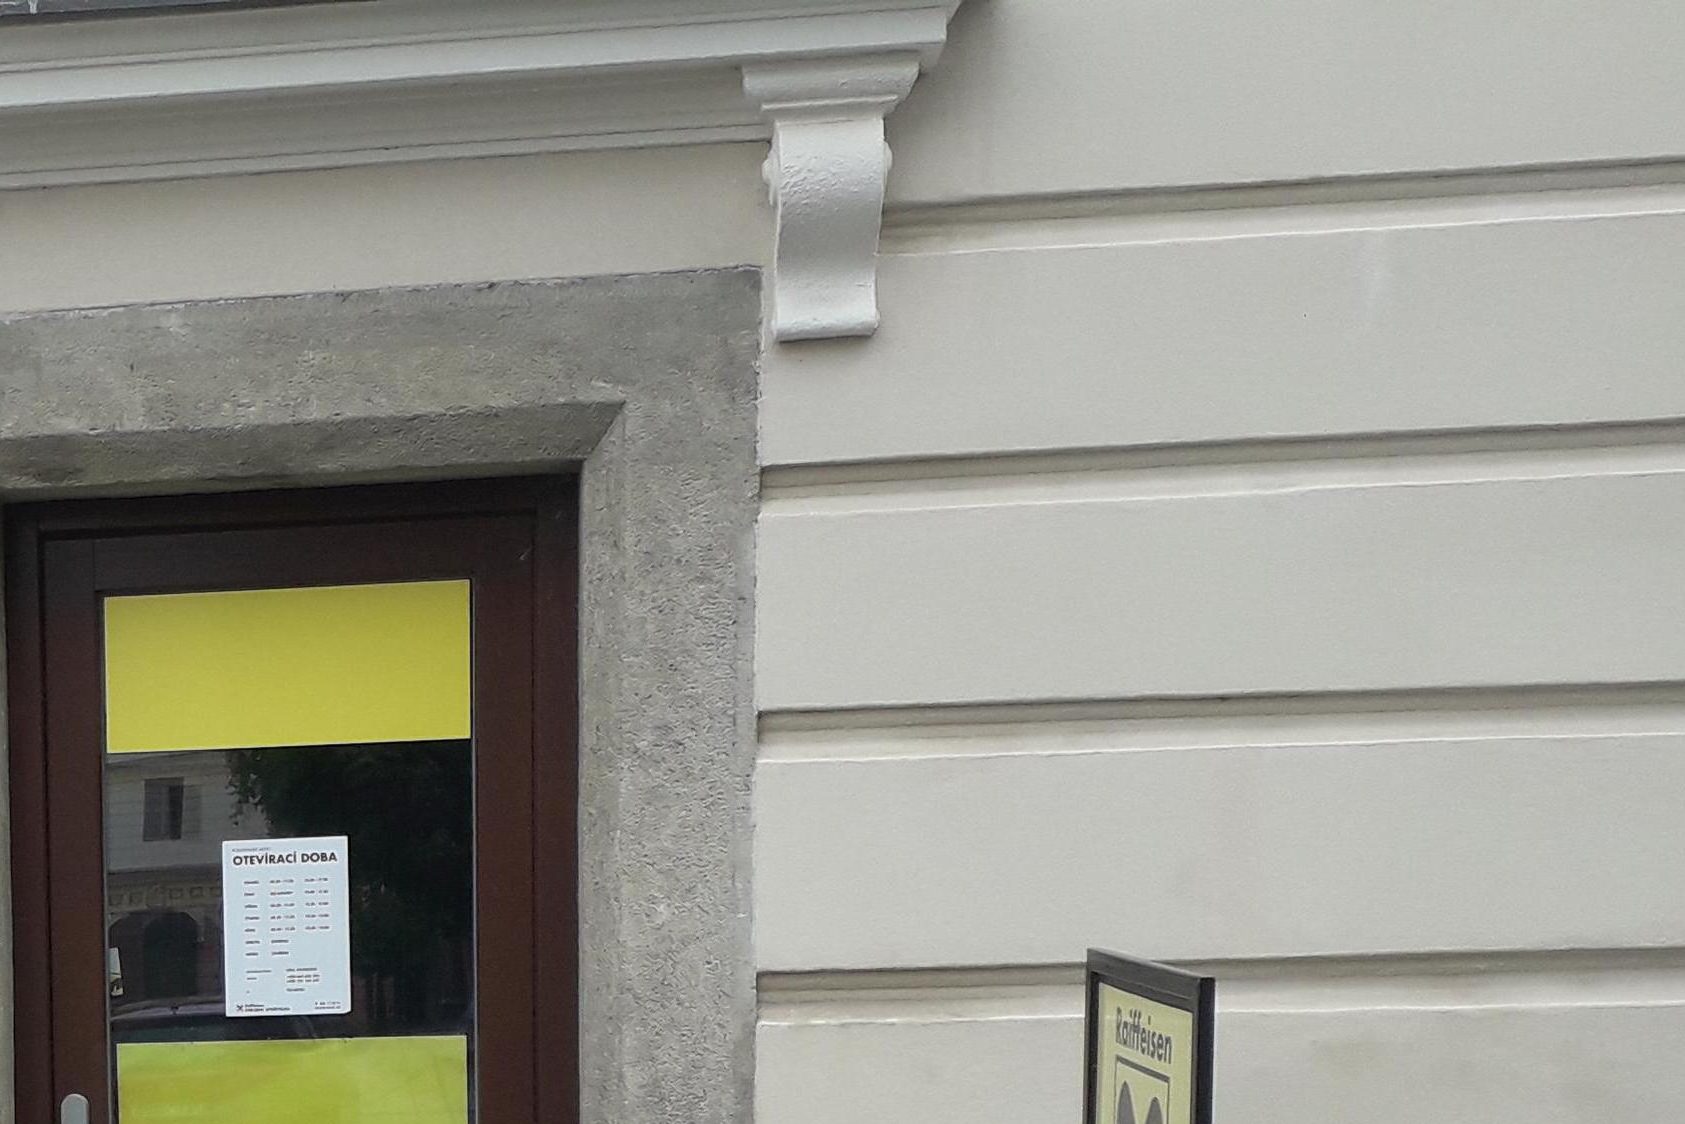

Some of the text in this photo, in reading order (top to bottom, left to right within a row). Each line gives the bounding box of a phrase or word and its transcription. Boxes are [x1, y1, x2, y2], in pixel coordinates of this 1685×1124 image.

[232, 851, 338, 866] OTEVÍRACÍ DOBA
[1116, 1006, 1172, 1064] Raiffeisen
